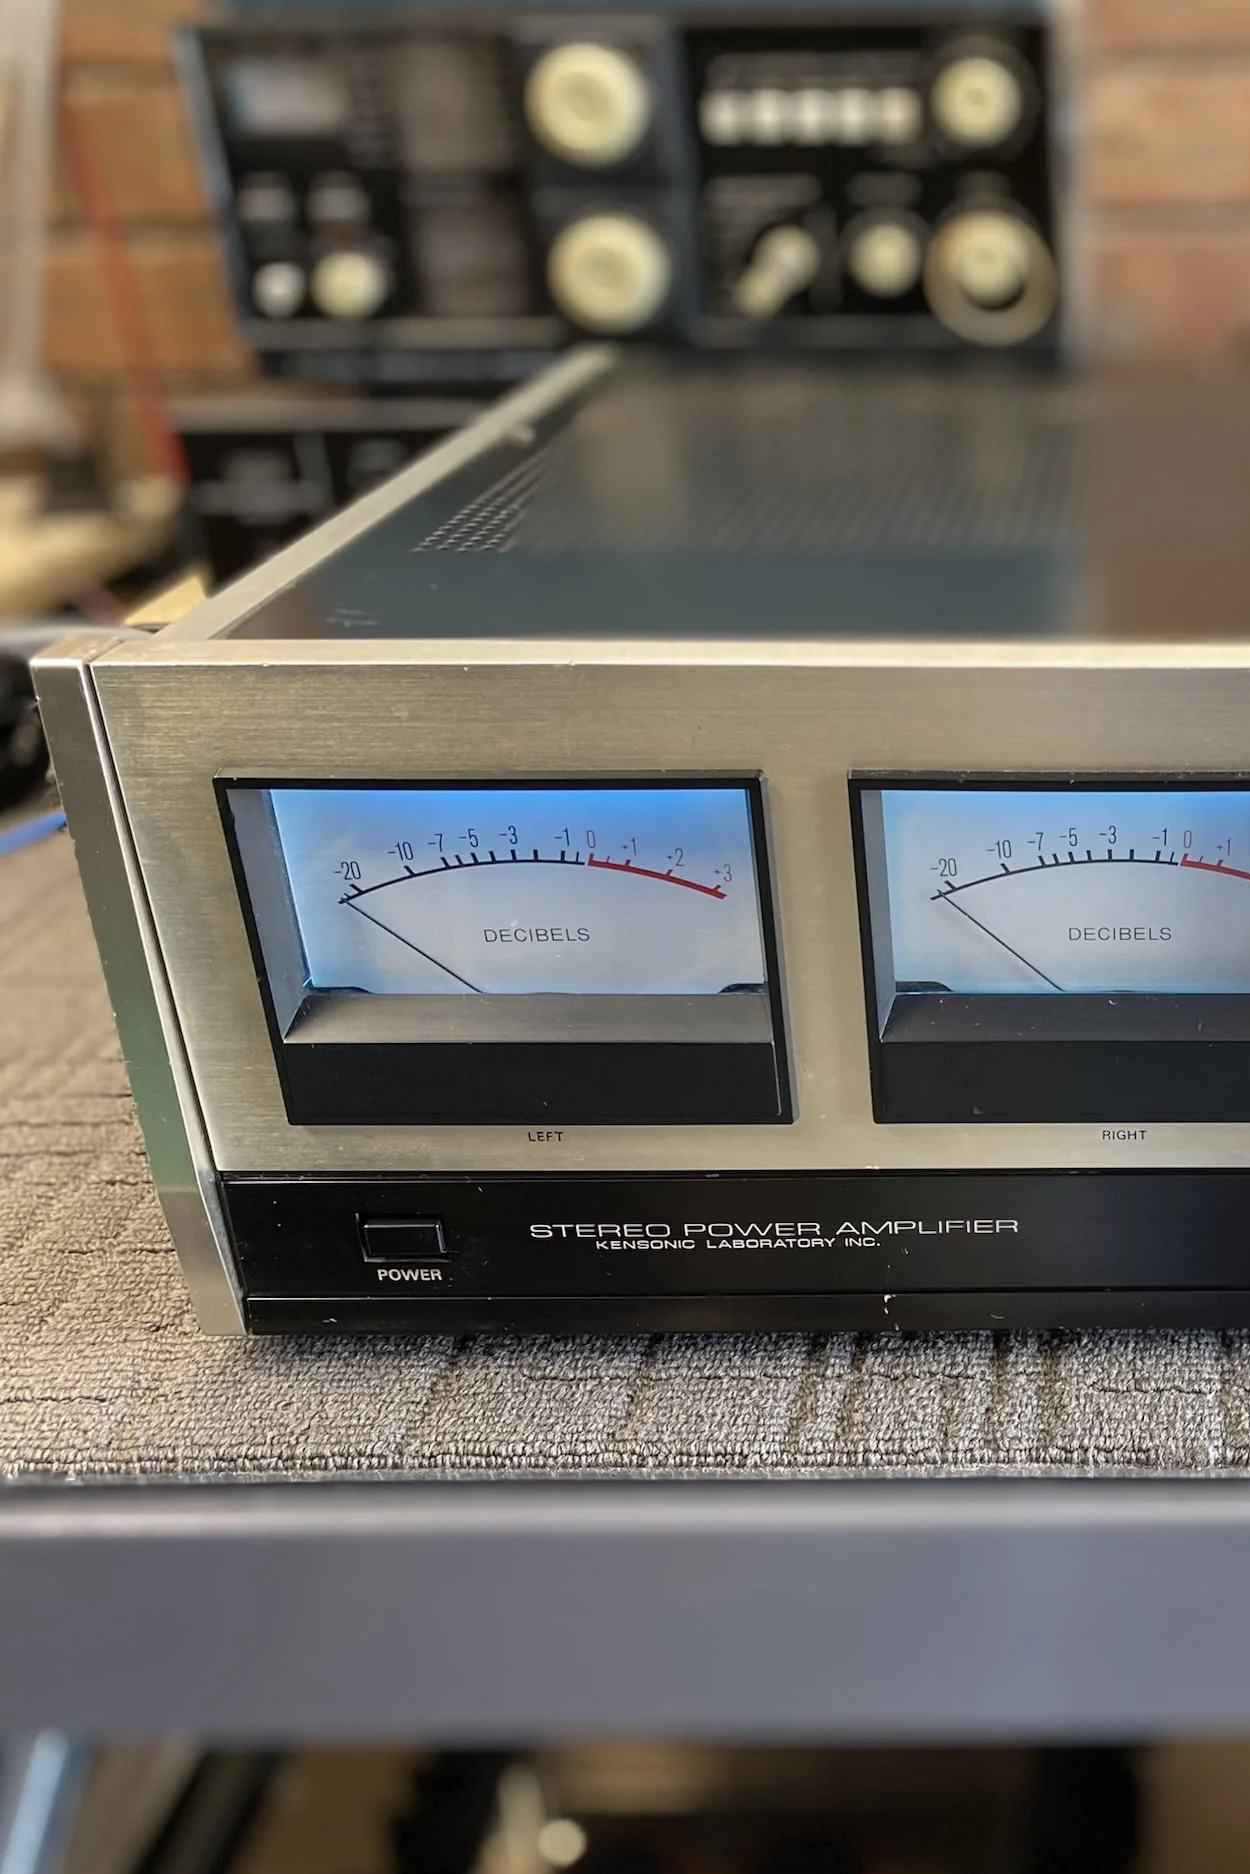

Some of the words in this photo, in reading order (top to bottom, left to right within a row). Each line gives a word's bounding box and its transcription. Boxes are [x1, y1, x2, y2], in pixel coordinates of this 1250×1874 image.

[333, 861, 362, 881] -20
[387, 841, 414, 862] -10
[427, 832, 444, 852] -7
[458, 828, 480, 848] -5
[499, 825, 519, 845] -3
[553, 827, 571, 846] -1
[586, 829, 597, 849] 0
[930, 857, 958, 877] -20
[986, 839, 1013, 859] -10
[1027, 831, 1045, 851] -7
[1058, 827, 1079, 847] -5
[1099, 825, 1118, 845] -3
[1151, 827, 1168, 847] -1
[1183, 829, 1193, 849] 0
[483, 927, 591, 944] DECIBELS
[1067, 926, 1173, 942] DECIBELS
[527, 1131, 565, 1143] LEFT
[1101, 1129, 1148, 1142] RIGHT
[529, 1222, 672, 1239] STEREO
[683, 1221, 822, 1238] POWER
[835, 1218, 1020, 1236] AMPLIFIER
[595, 1239, 696, 1251] KENSONIC
[706, 1238, 837, 1250] LABORATORY
[844, 1236, 881, 1248] INC.
[377, 1267, 443, 1283] POWER
